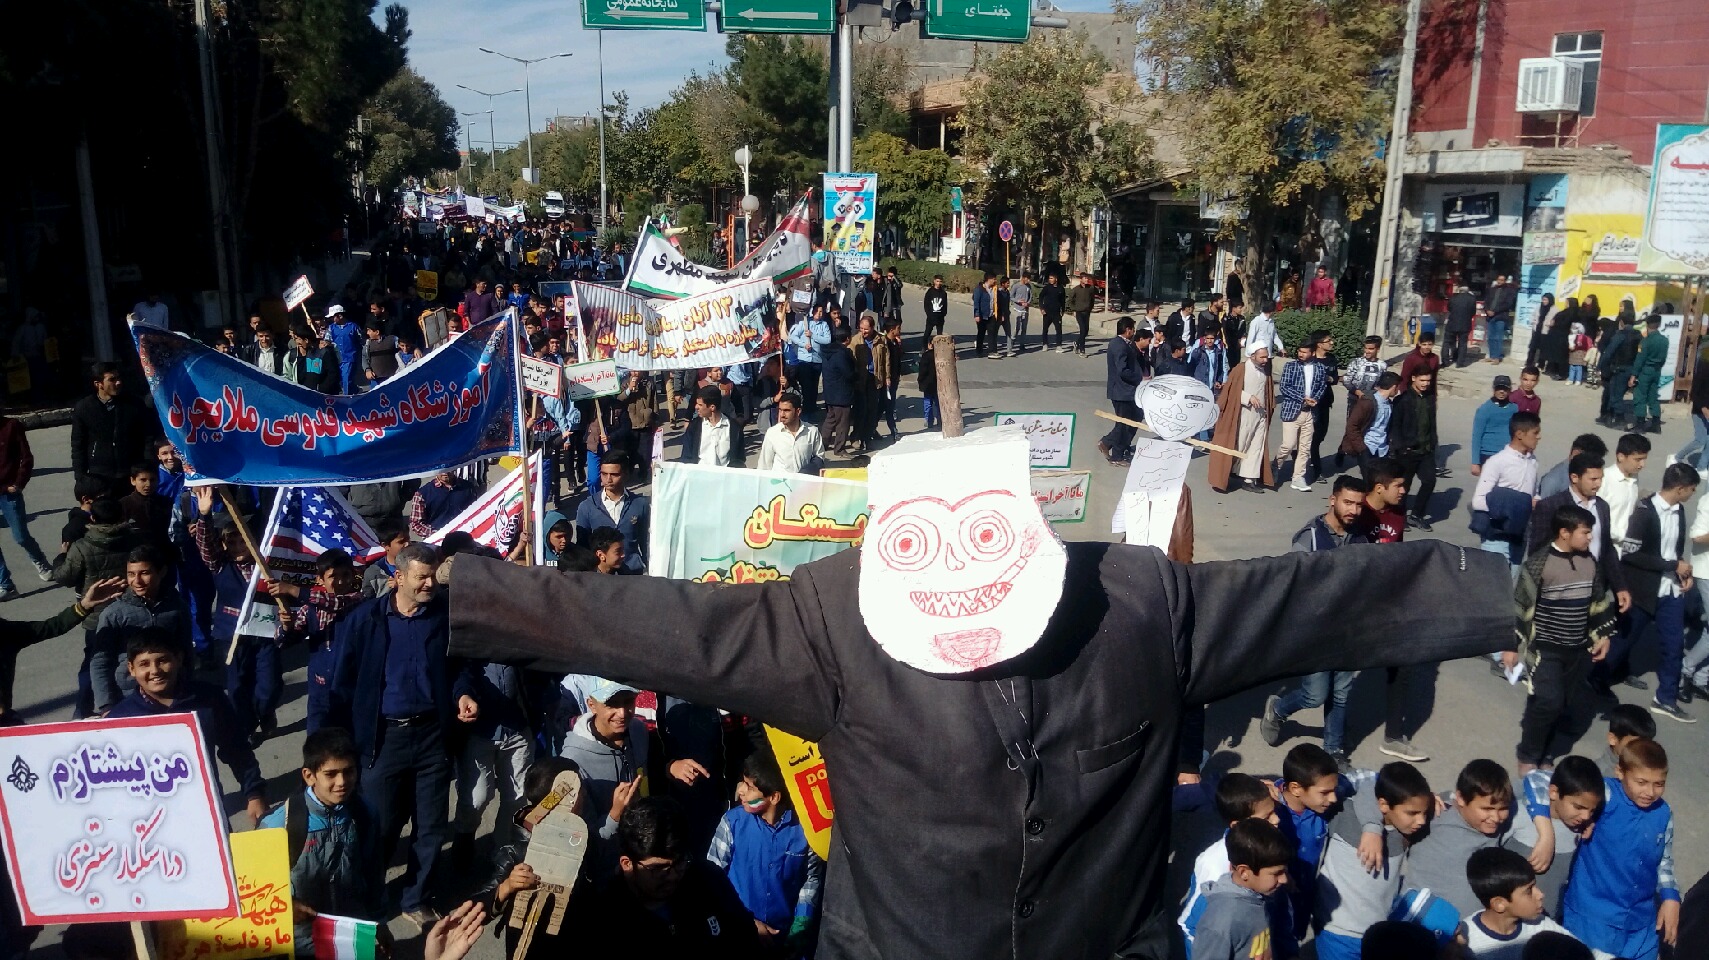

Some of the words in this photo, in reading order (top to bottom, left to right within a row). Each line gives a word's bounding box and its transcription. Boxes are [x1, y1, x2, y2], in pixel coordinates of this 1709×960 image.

[964, 2, 1012, 20] جغتای
[651, 252, 703, 279] مطهری
[682, 299, 712, 332] آبان
[398, 360, 492, 428] آموزشگاه
[167, 385, 259, 444] ملایجرد
[261, 398, 340, 450] قدوسی
[342, 394, 397, 442] شهید
[1039, 421, 1054, 438] شهید
[1050, 422, 1067, 437] دبستان
[1029, 454, 1054, 462] شهرستا
[1040, 447, 1061, 455] سازمان
[788, 745, 814, 767] است
[52, 746, 150, 800] پیشتازم
[150, 754, 190, 793] من
[262, 936, 273, 952] و
[274, 927, 291, 945] ما
